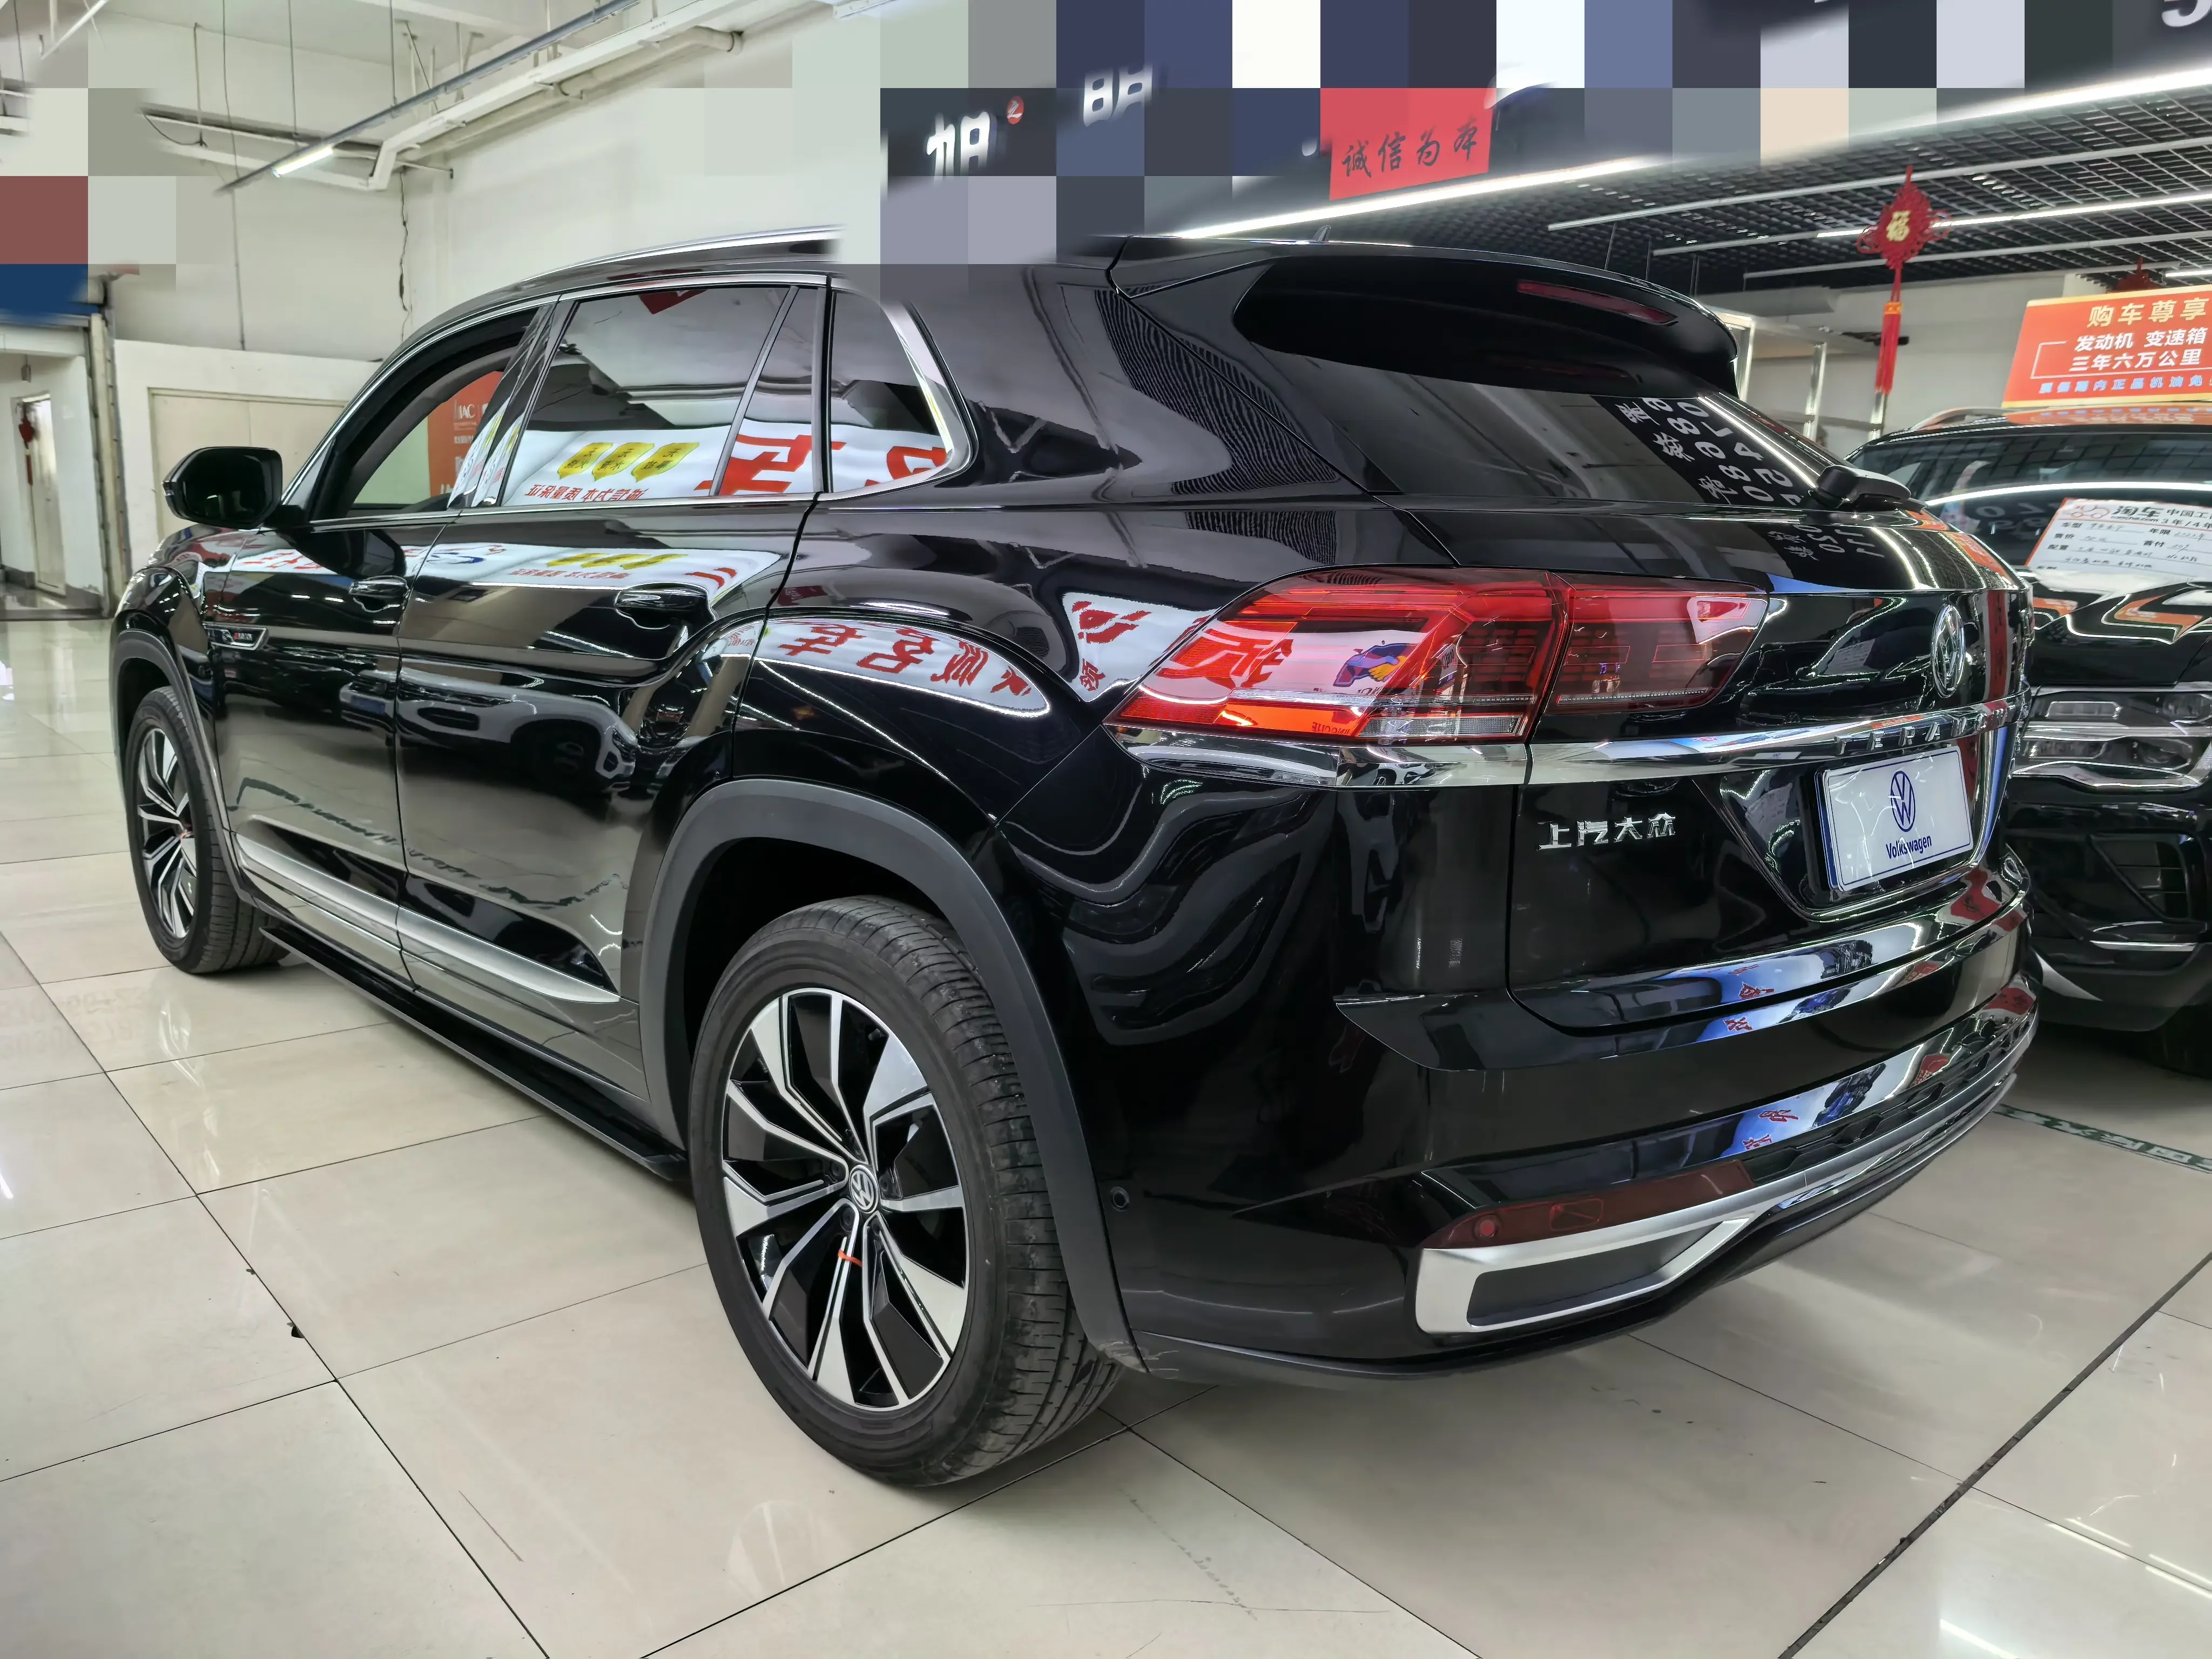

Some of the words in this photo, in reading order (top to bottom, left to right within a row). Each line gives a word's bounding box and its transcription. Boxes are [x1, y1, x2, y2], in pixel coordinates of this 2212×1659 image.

[1341, 116, 1478, 178] 诚信为本
[1885, 210, 1912, 242] 福
[2087, 297, 2209, 328] 购车尊享
[2074, 332, 2134, 352] 发动机
[2143, 326, 2208, 348] 变速箱
[2069, 348, 2202, 372] 三年六万公里
[2167, 508, 2212, 520] 中国工
[1536, 812, 1676, 851] 上汽大众
[1886, 835, 1932, 859] Volkswagen
